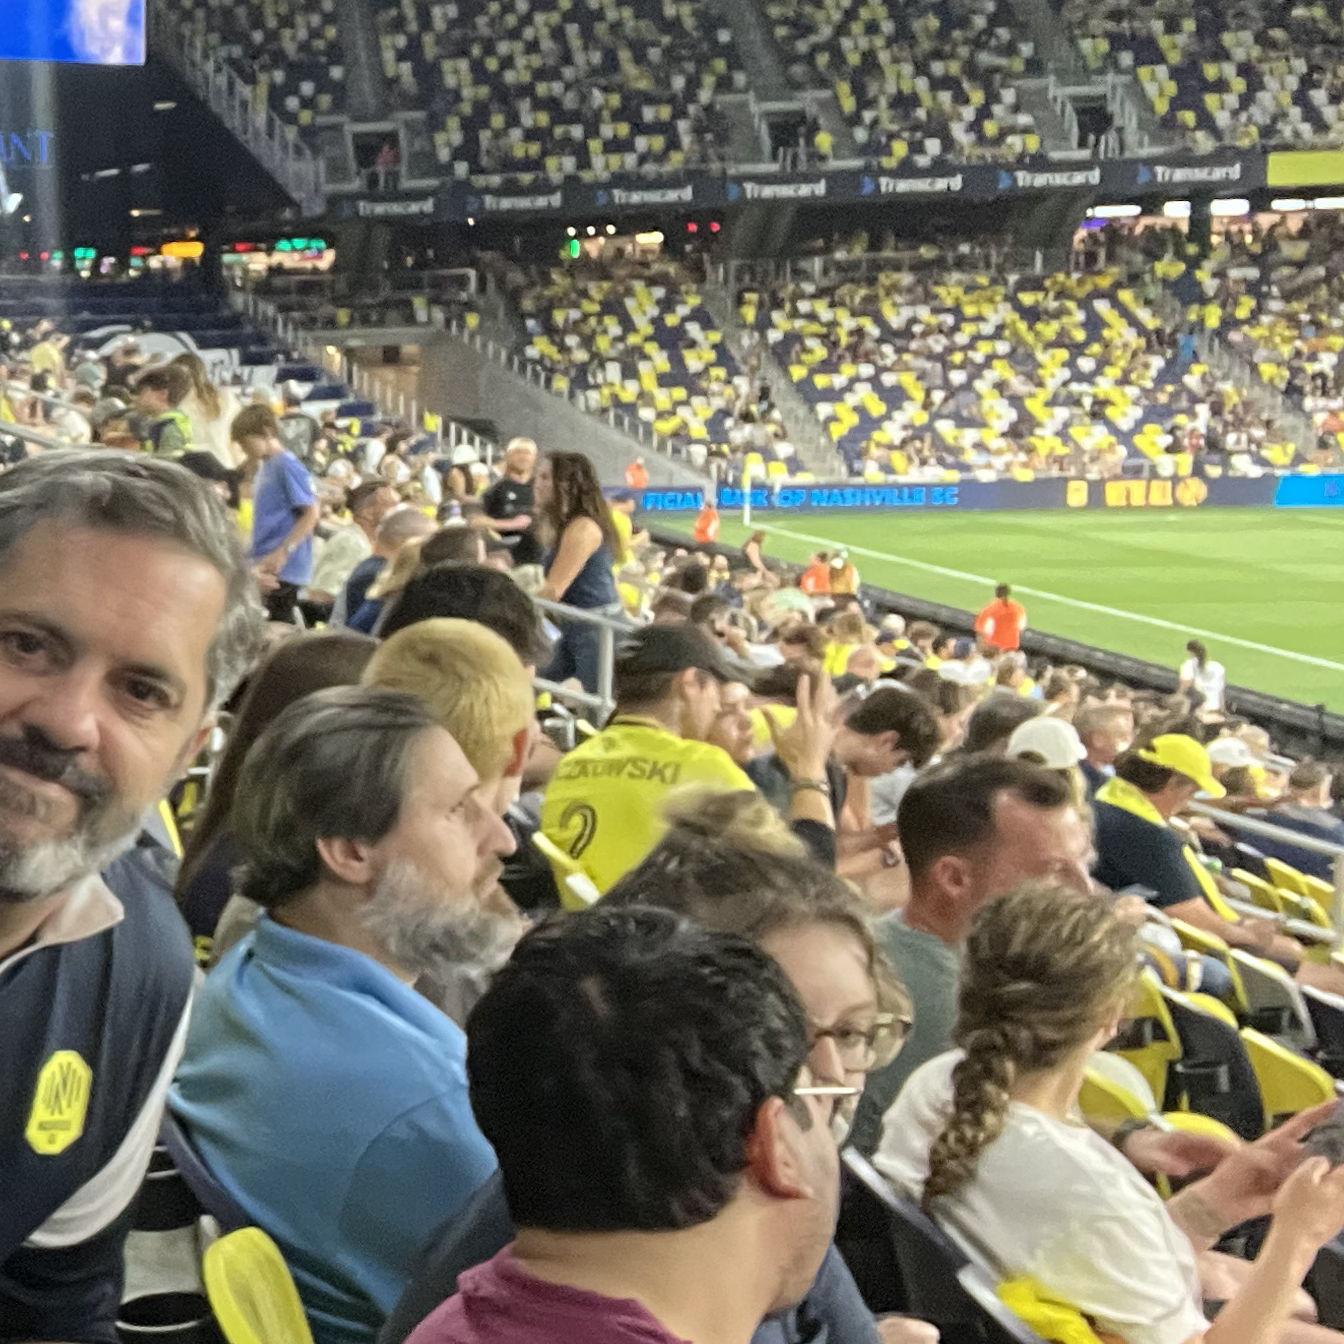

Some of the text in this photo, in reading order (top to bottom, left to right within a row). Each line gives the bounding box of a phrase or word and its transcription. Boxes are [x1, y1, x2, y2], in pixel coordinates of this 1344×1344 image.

[1015, 167, 1101, 187] Transcard
[1155, 162, 1241, 183] Transcard
[743, 178, 826, 199] Transcard
[879, 173, 963, 194] Transcard
[719, 488, 769, 506] BAK
[812, 487, 926, 506] NASHVILLE
